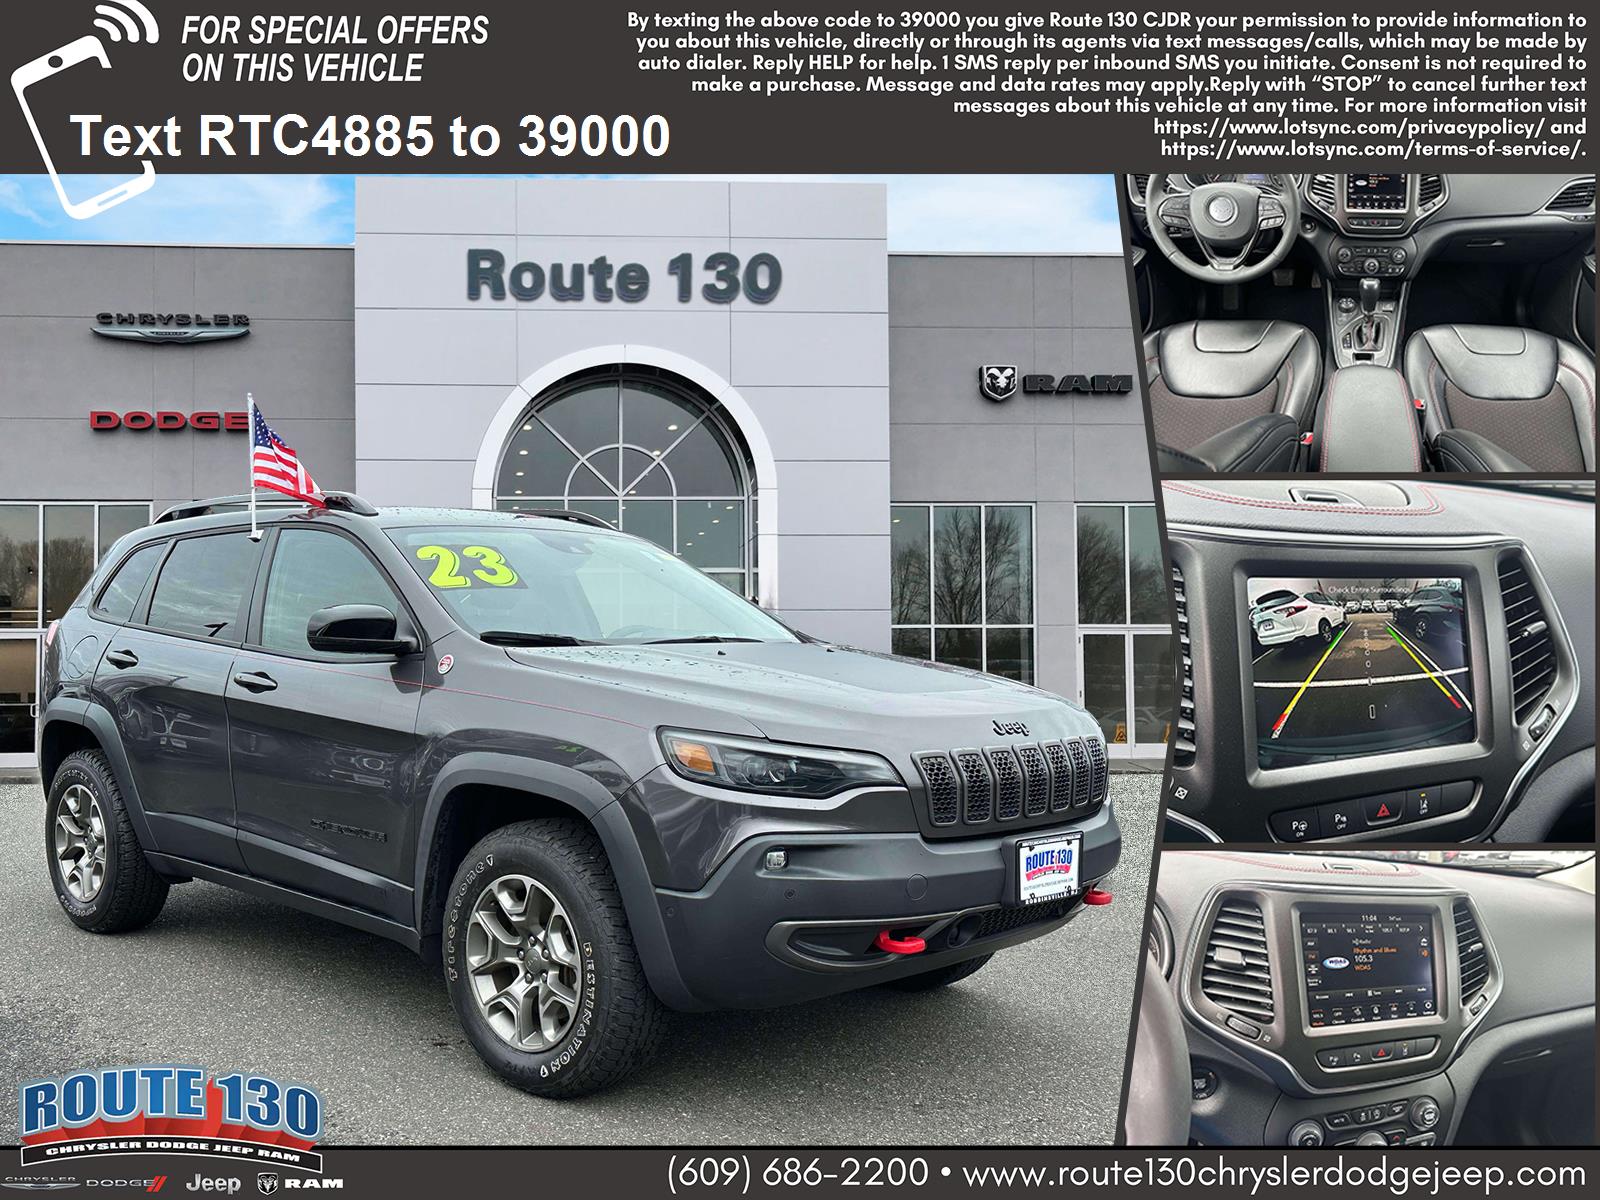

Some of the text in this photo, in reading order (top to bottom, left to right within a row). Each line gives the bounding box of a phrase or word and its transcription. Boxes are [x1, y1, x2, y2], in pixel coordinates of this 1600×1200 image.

[467, 248, 783, 305] Route 130
[95, 312, 250, 327] CHRYSLER
[1022, 374, 1134, 395] RAM
[89, 410, 249, 431] DODGE
[415, 544, 519, 589] 23
[1328, 585, 1411, 596] Check Entire Surroundings
[992, 719, 1030, 737] Jeep
[1026, 849, 1056, 872] ROUTE
[1057, 849, 1072, 865] 130
[1361, 914, 1377, 922] 11:04
[550, 942, 596, 1073] DESTINATION
